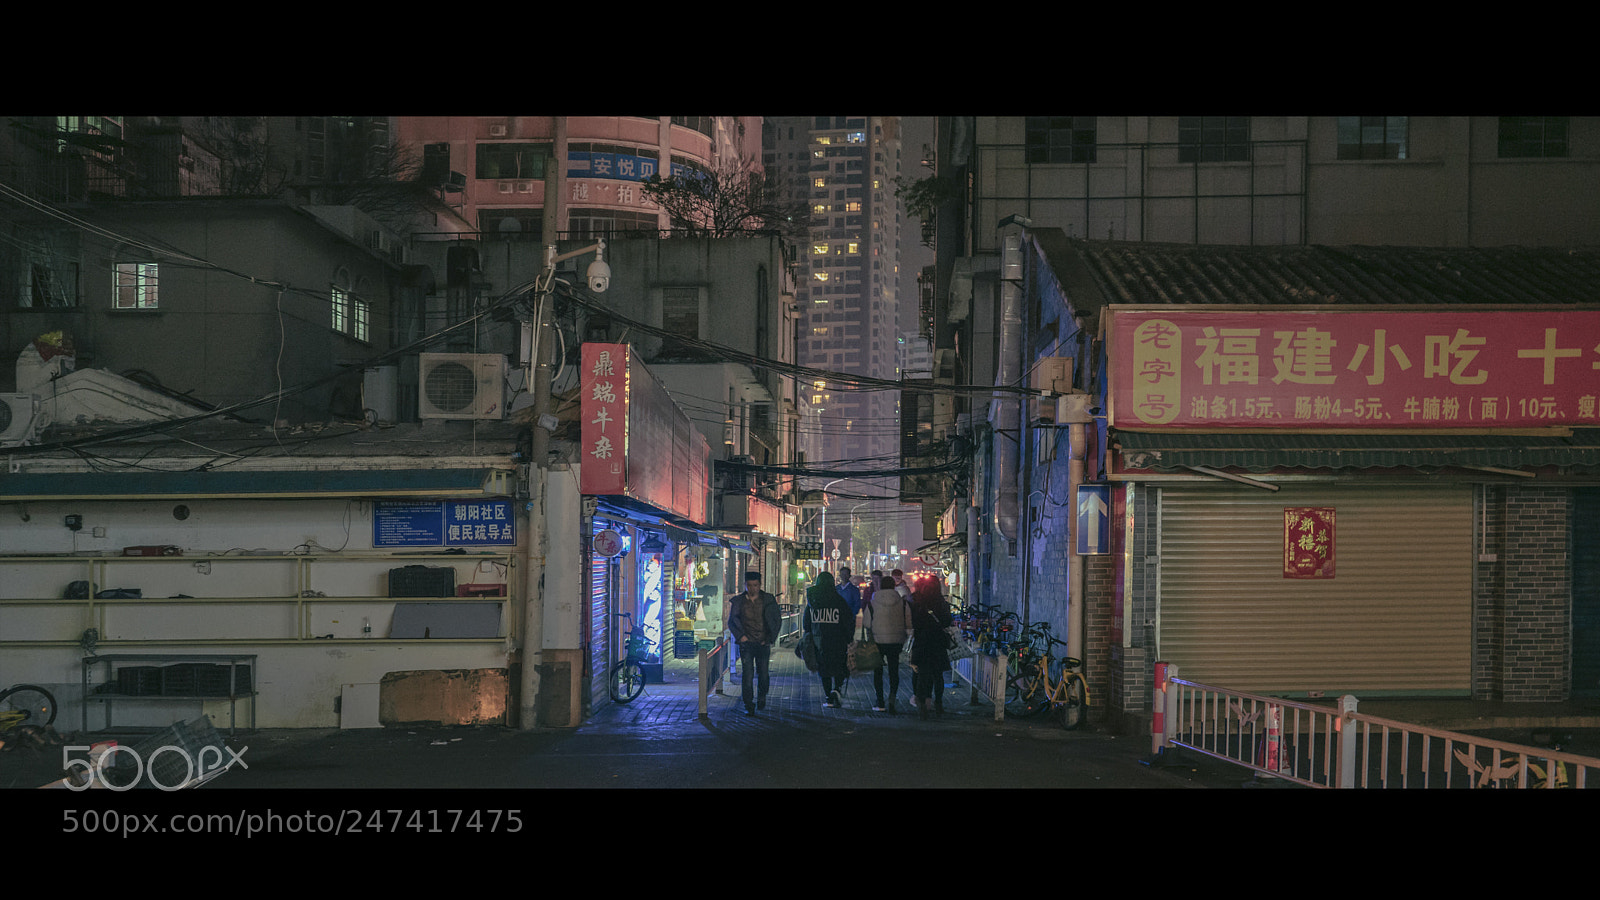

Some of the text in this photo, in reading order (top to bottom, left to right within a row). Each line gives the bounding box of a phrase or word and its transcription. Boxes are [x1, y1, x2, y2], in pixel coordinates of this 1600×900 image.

[1138, 322, 1177, 420] 老字号
[1195, 326, 1600, 385] 福建小吃 十
[590, 350, 616, 460] 鼎端牛杂
[454, 504, 507, 521] 朝阳社区
[448, 523, 513, 541] 便民疏导点
[1298, 517, 1315, 550] 新禧
[1314, 528, 1330, 559] 恭贺
[809, 607, 840, 623] YOUNG
